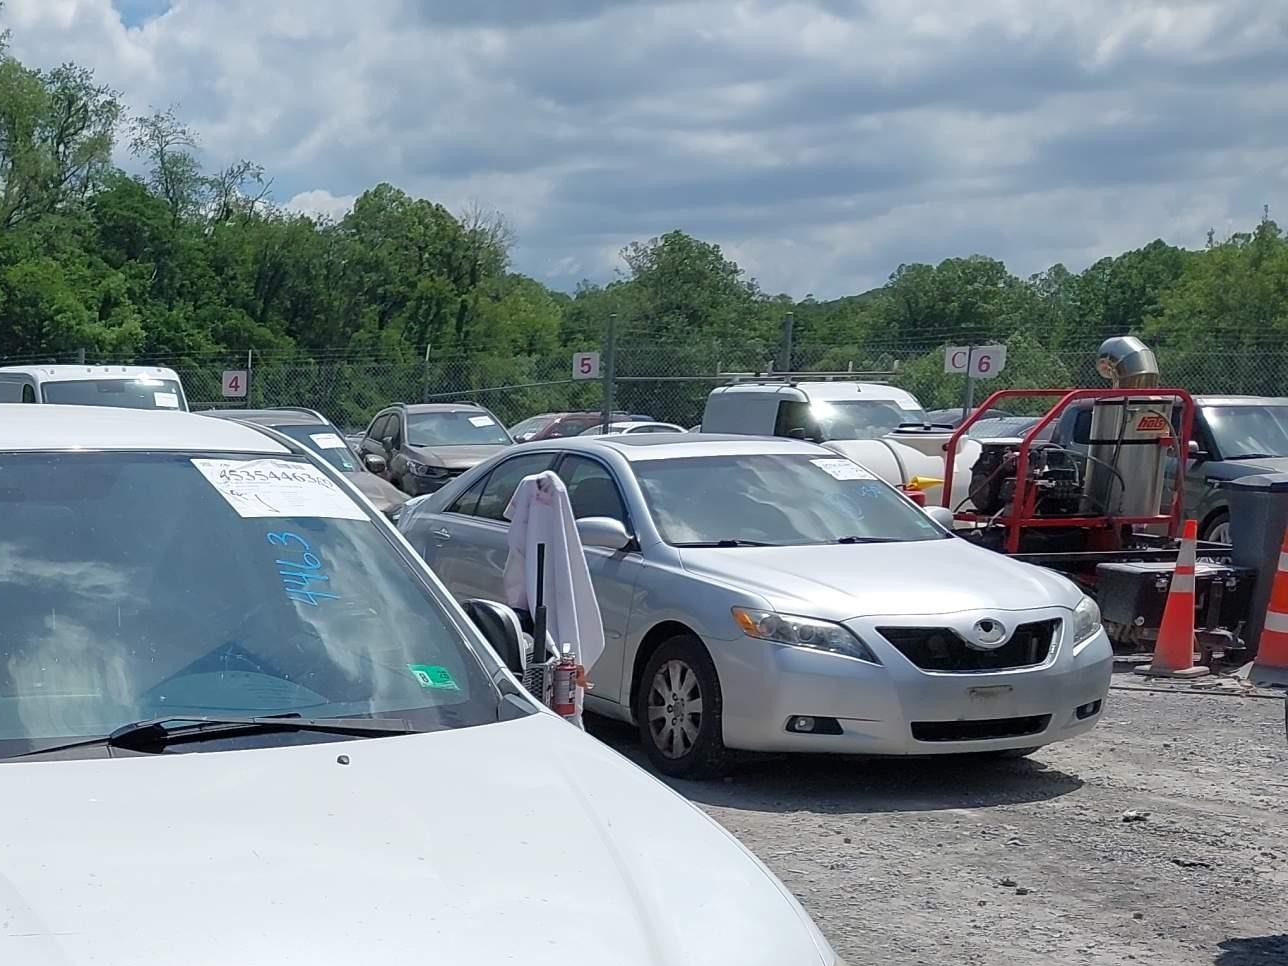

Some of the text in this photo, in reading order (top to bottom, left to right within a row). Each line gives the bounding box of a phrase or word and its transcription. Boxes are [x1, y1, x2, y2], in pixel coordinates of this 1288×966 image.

[580, 357, 592, 374] 5
[952, 351, 966, 369] C
[978, 355, 991, 373] 6
[228, 375, 241, 392] 4
[266, 532, 342, 606] 4463
